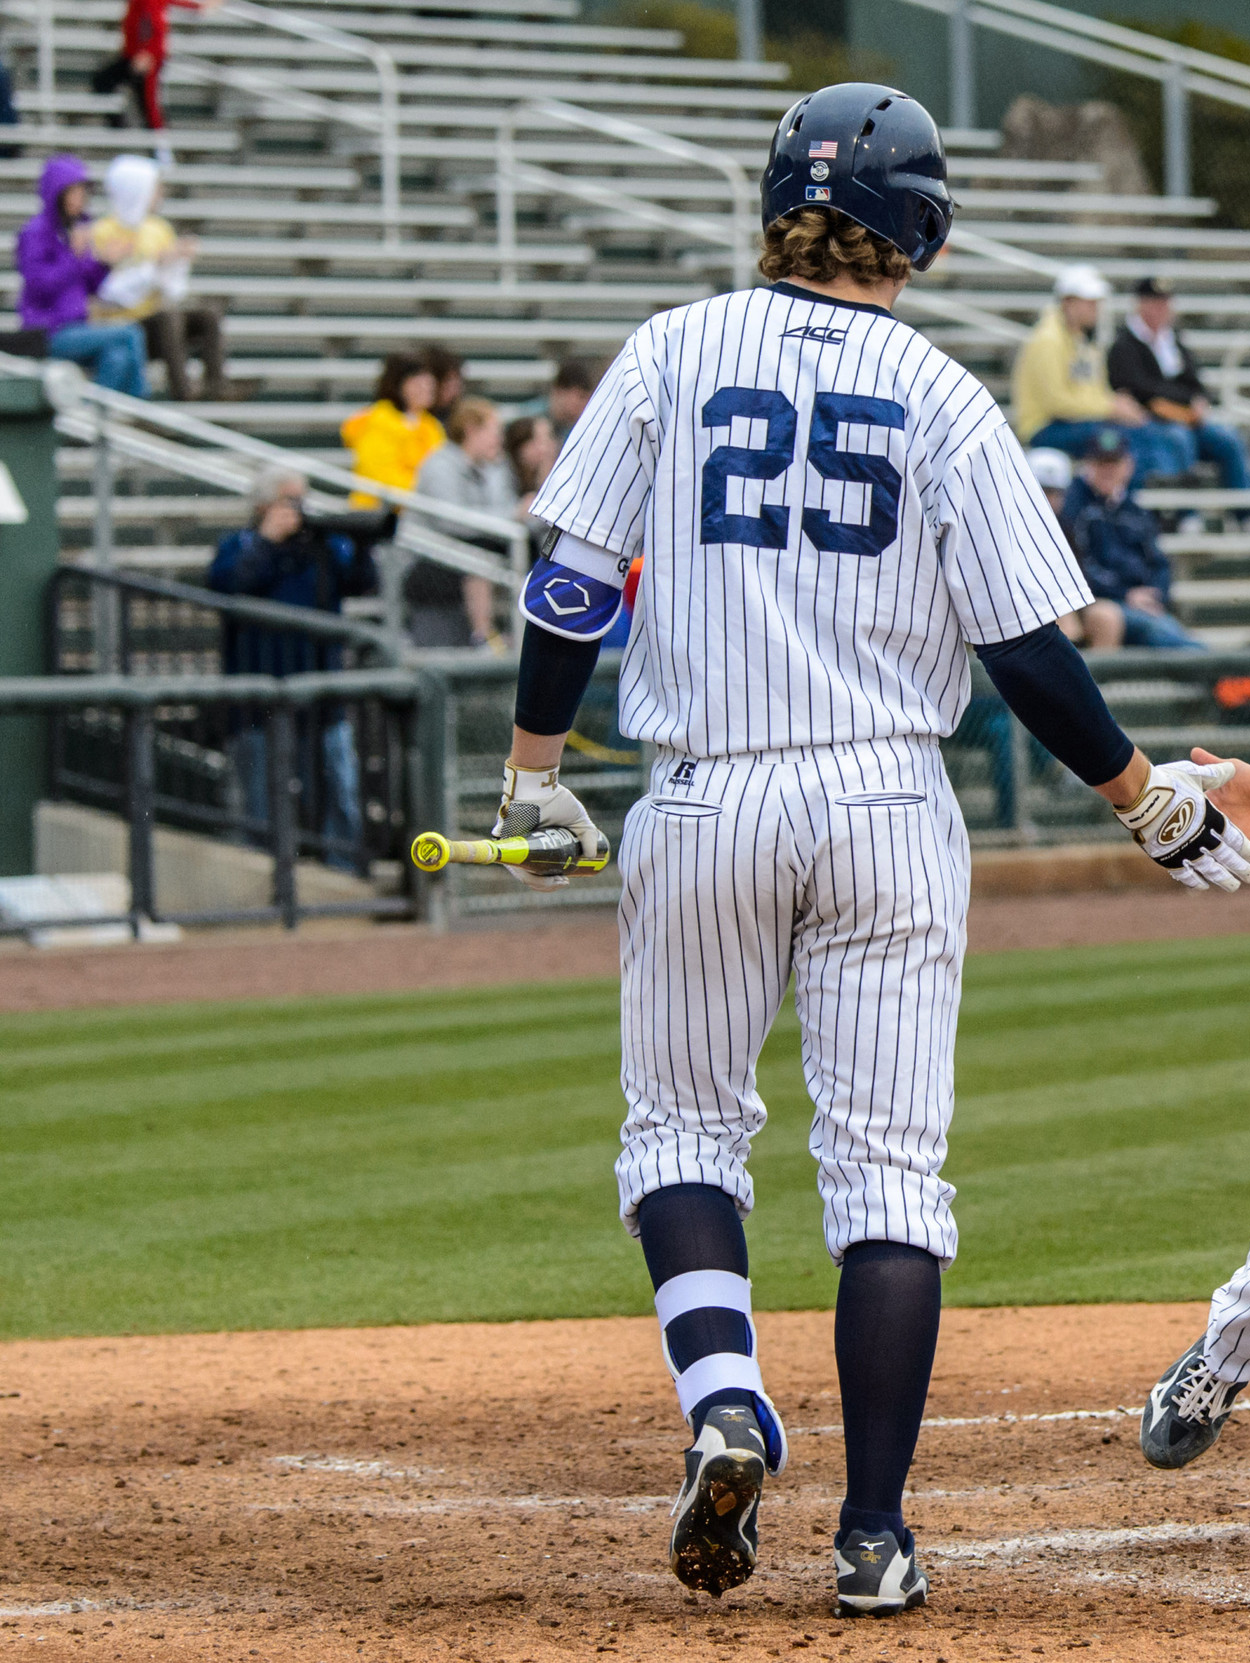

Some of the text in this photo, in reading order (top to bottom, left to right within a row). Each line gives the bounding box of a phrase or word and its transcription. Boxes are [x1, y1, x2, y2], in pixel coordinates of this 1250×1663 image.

[778, 326, 849, 344] ACC
[700, 387, 905, 557] 25
[668, 777, 695, 786] RUSSELL
